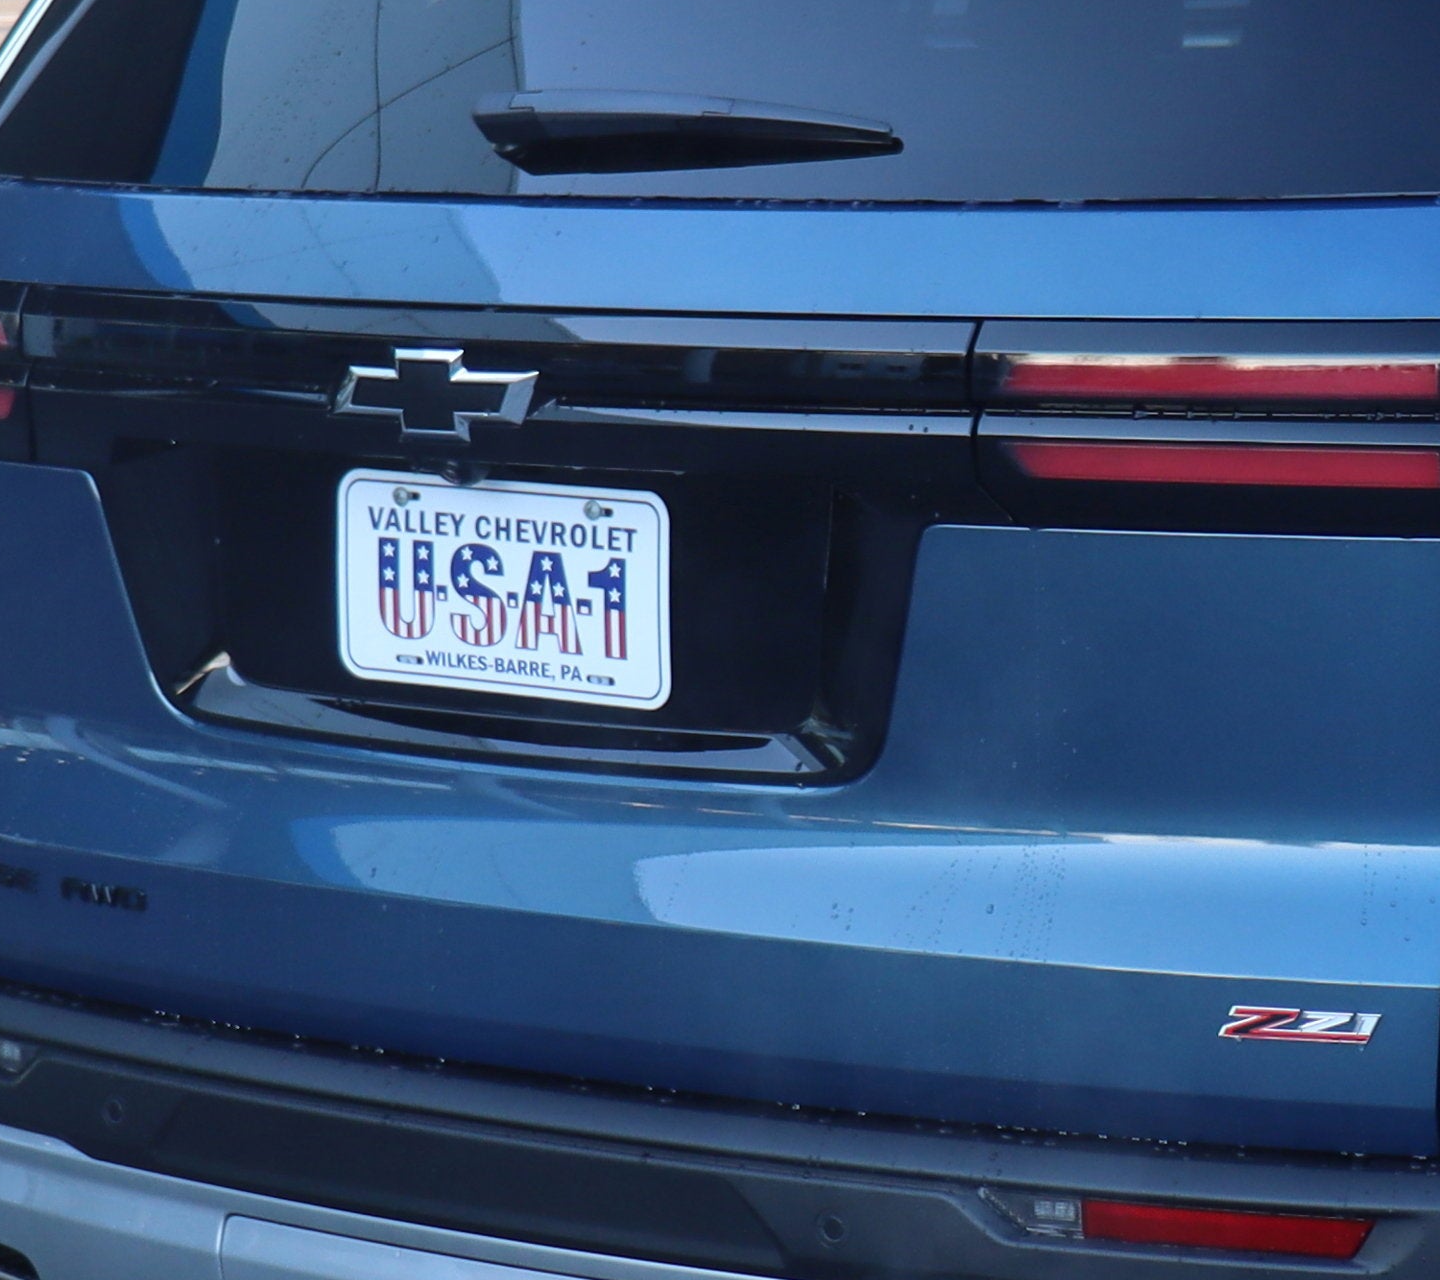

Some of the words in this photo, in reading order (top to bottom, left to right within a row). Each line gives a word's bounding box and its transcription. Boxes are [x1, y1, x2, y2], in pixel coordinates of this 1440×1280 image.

[368, 505, 466, 537] VALLEY
[475, 514, 638, 553] CHEVROLET
[425, 650, 556, 682] WILKES-BARRE,
[561, 664, 583, 682] PA
[1218, 1005, 1383, 1044] Z71
